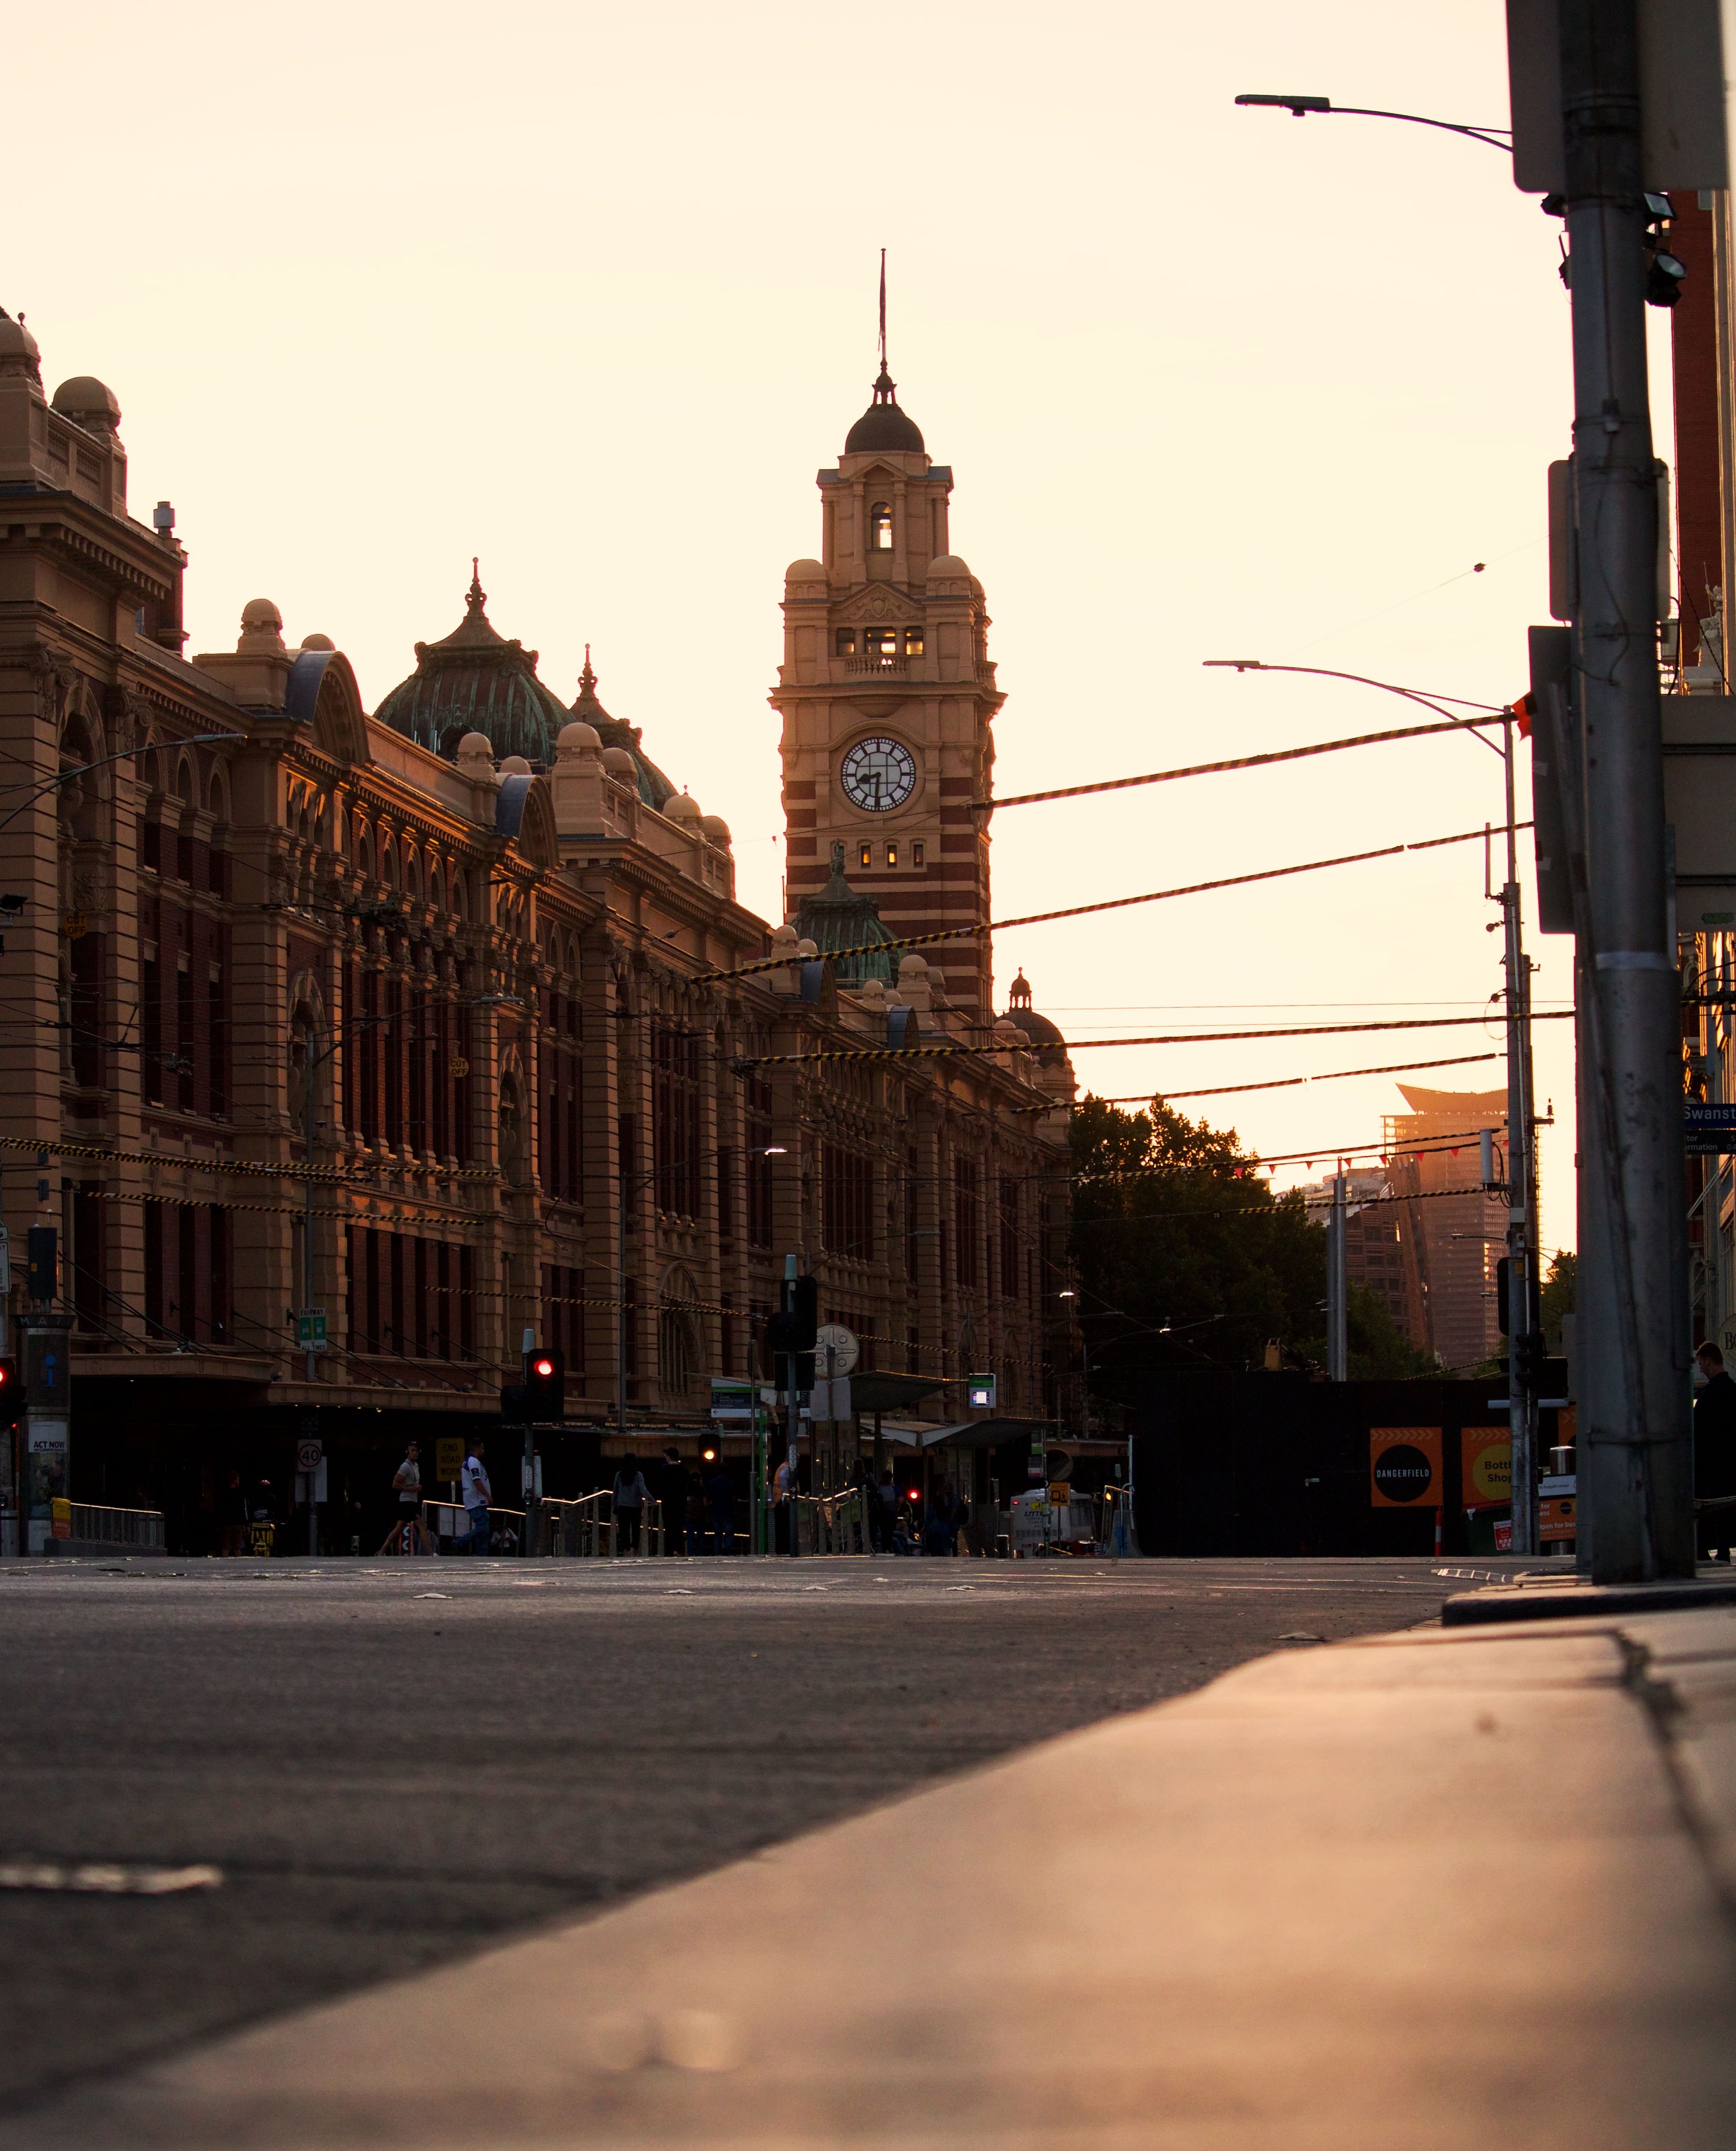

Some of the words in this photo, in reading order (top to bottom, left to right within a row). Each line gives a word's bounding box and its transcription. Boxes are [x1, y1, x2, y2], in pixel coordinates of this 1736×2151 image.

[302, 1450, 319, 1461] 40
[440, 1468, 460, 1476] WORK
[1377, 1469, 1429, 1478] DANGERFIELD
